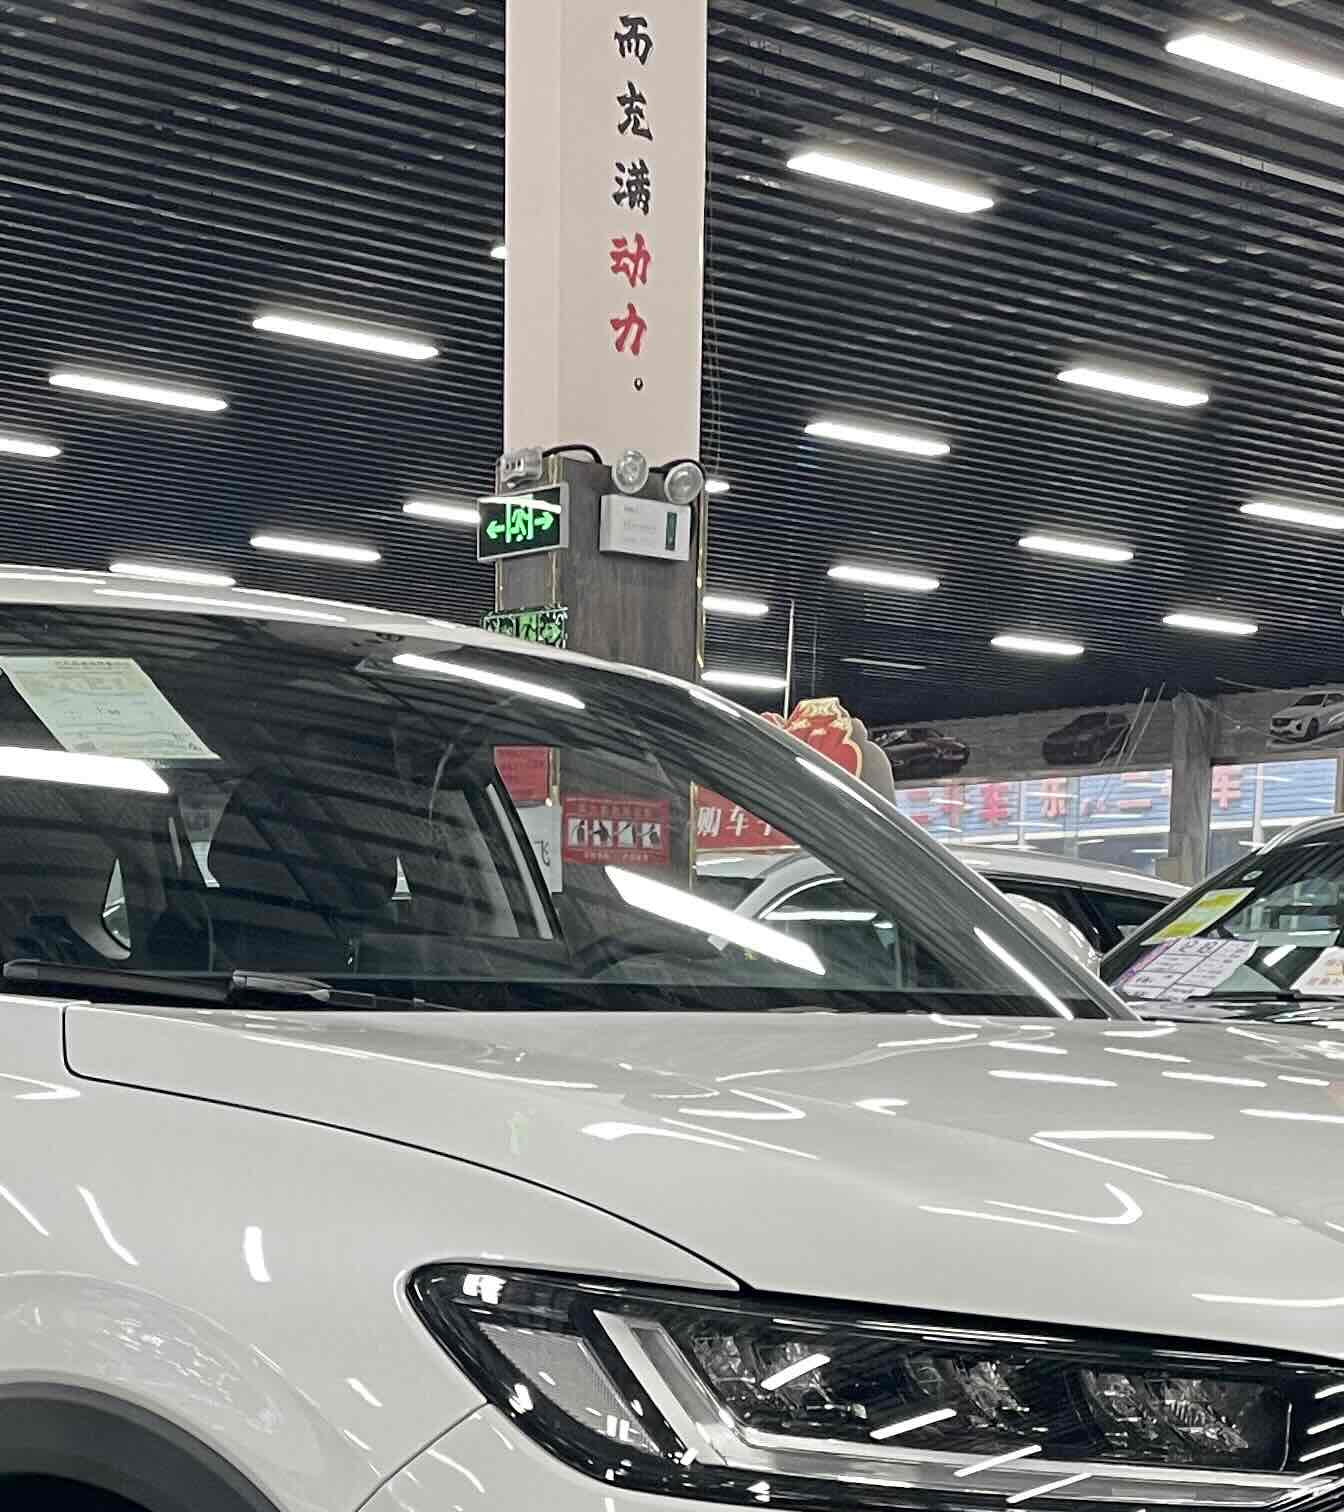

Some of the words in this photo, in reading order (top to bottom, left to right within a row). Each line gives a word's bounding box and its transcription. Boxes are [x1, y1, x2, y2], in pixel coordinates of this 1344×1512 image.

[610, 14, 655, 393] 而充满动力。
